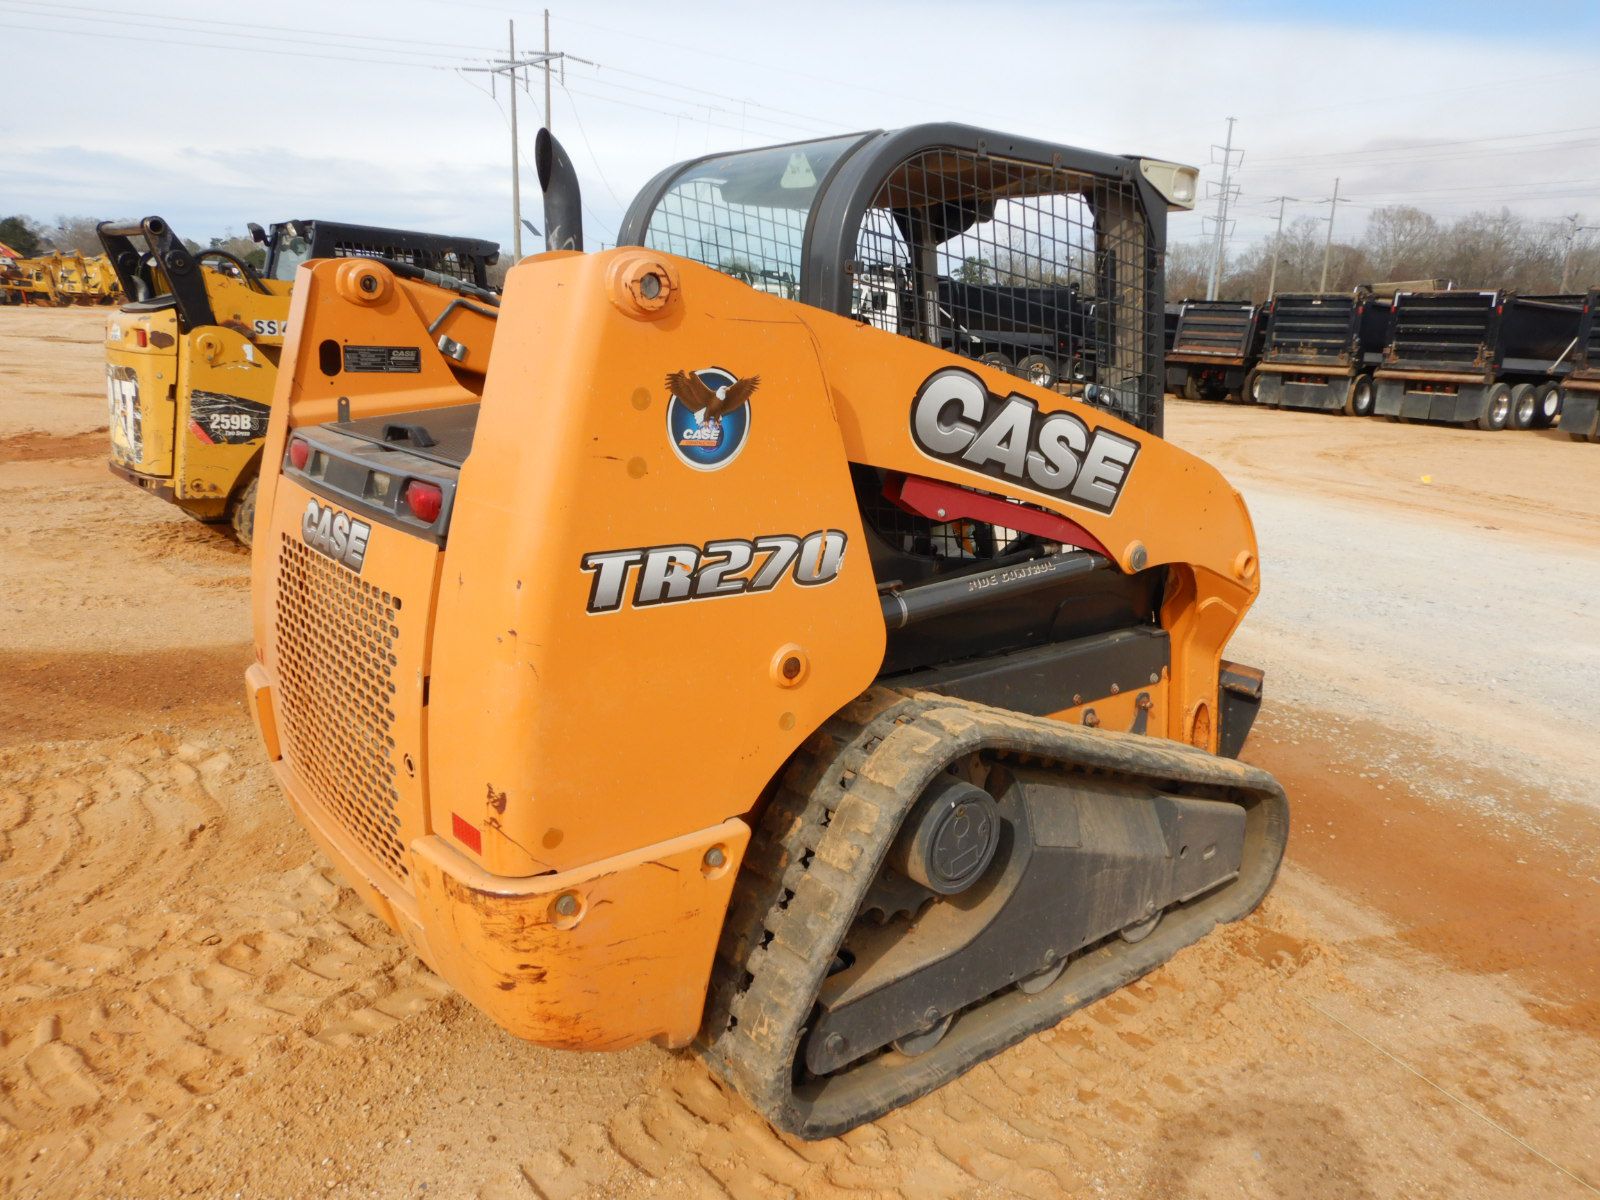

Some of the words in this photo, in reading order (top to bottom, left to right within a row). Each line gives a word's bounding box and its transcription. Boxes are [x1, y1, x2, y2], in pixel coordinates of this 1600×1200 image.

[683, 428, 720, 440] CASE
[912, 369, 1139, 514] CASE
[302, 498, 371, 574] CASE
[581, 530, 848, 614] TR270
